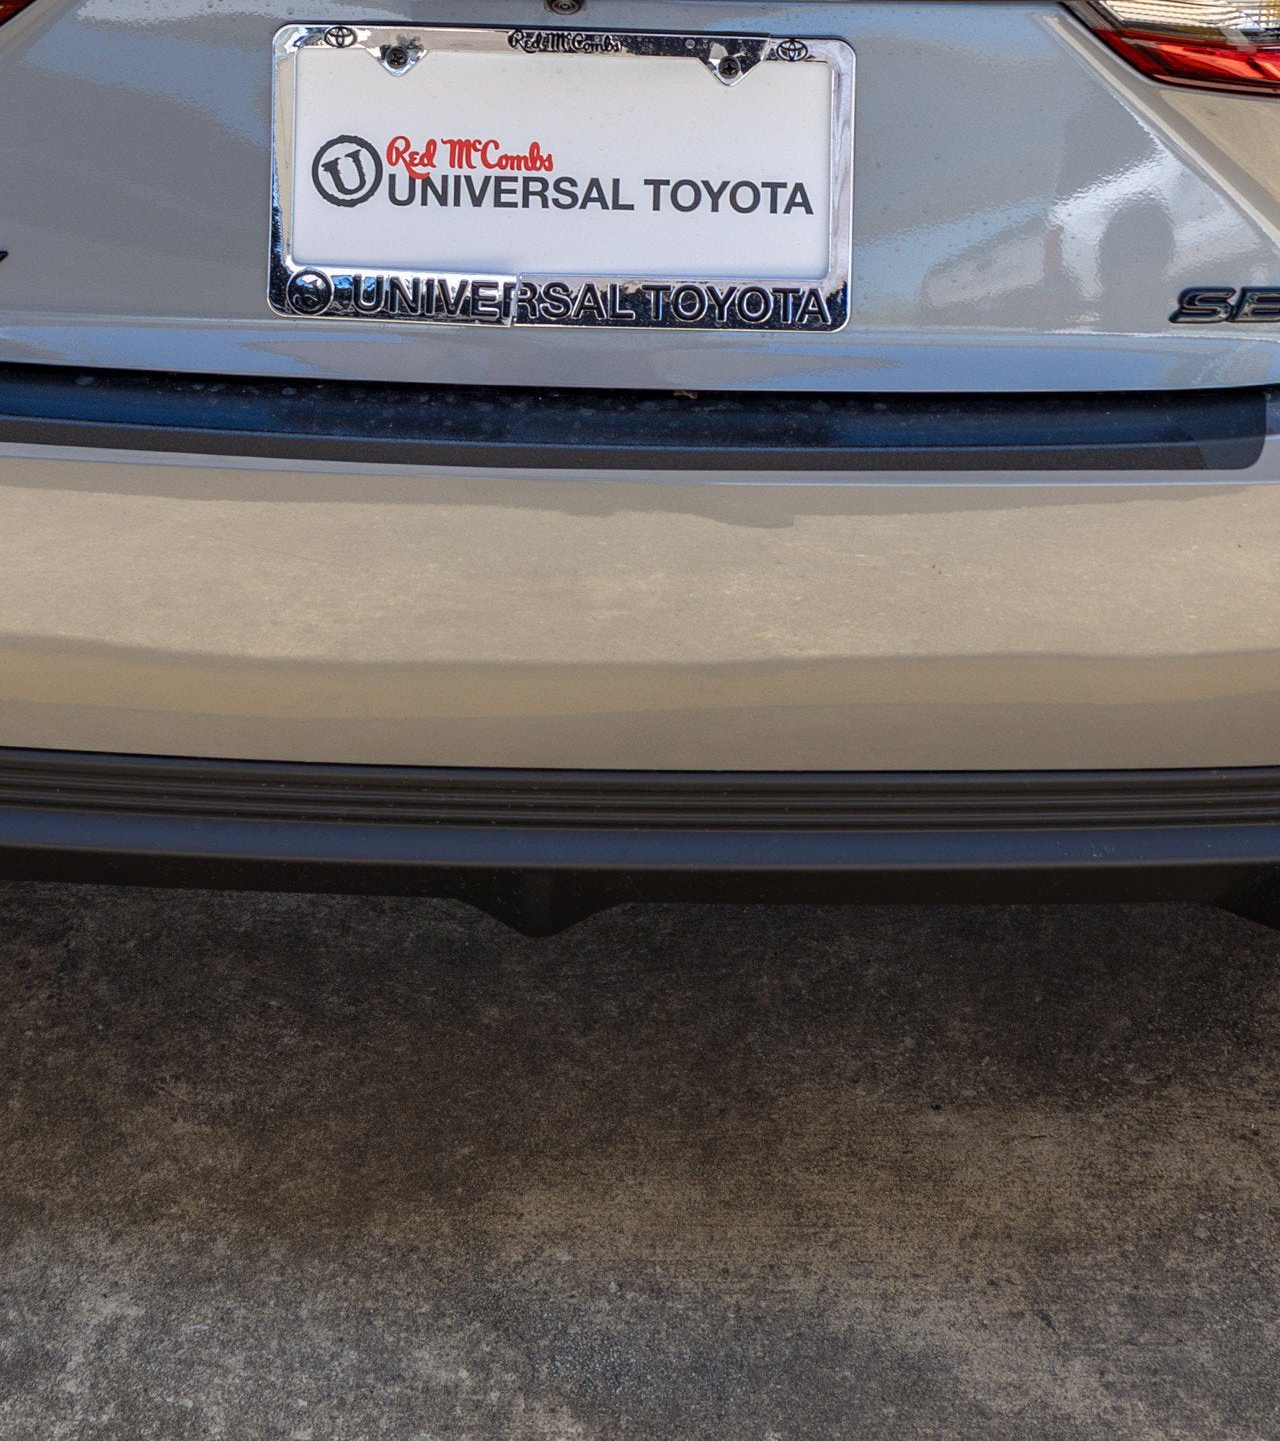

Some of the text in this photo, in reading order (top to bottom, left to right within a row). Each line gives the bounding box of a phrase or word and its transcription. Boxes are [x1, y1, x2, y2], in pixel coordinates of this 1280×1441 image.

[507, 29, 543, 54] Red
[386, 135, 554, 180] Red McCombs
[387, 172, 814, 216] UNIVERSAL TOYOTA
[351, 272, 832, 325] UNIVERSAL TOYOTA
